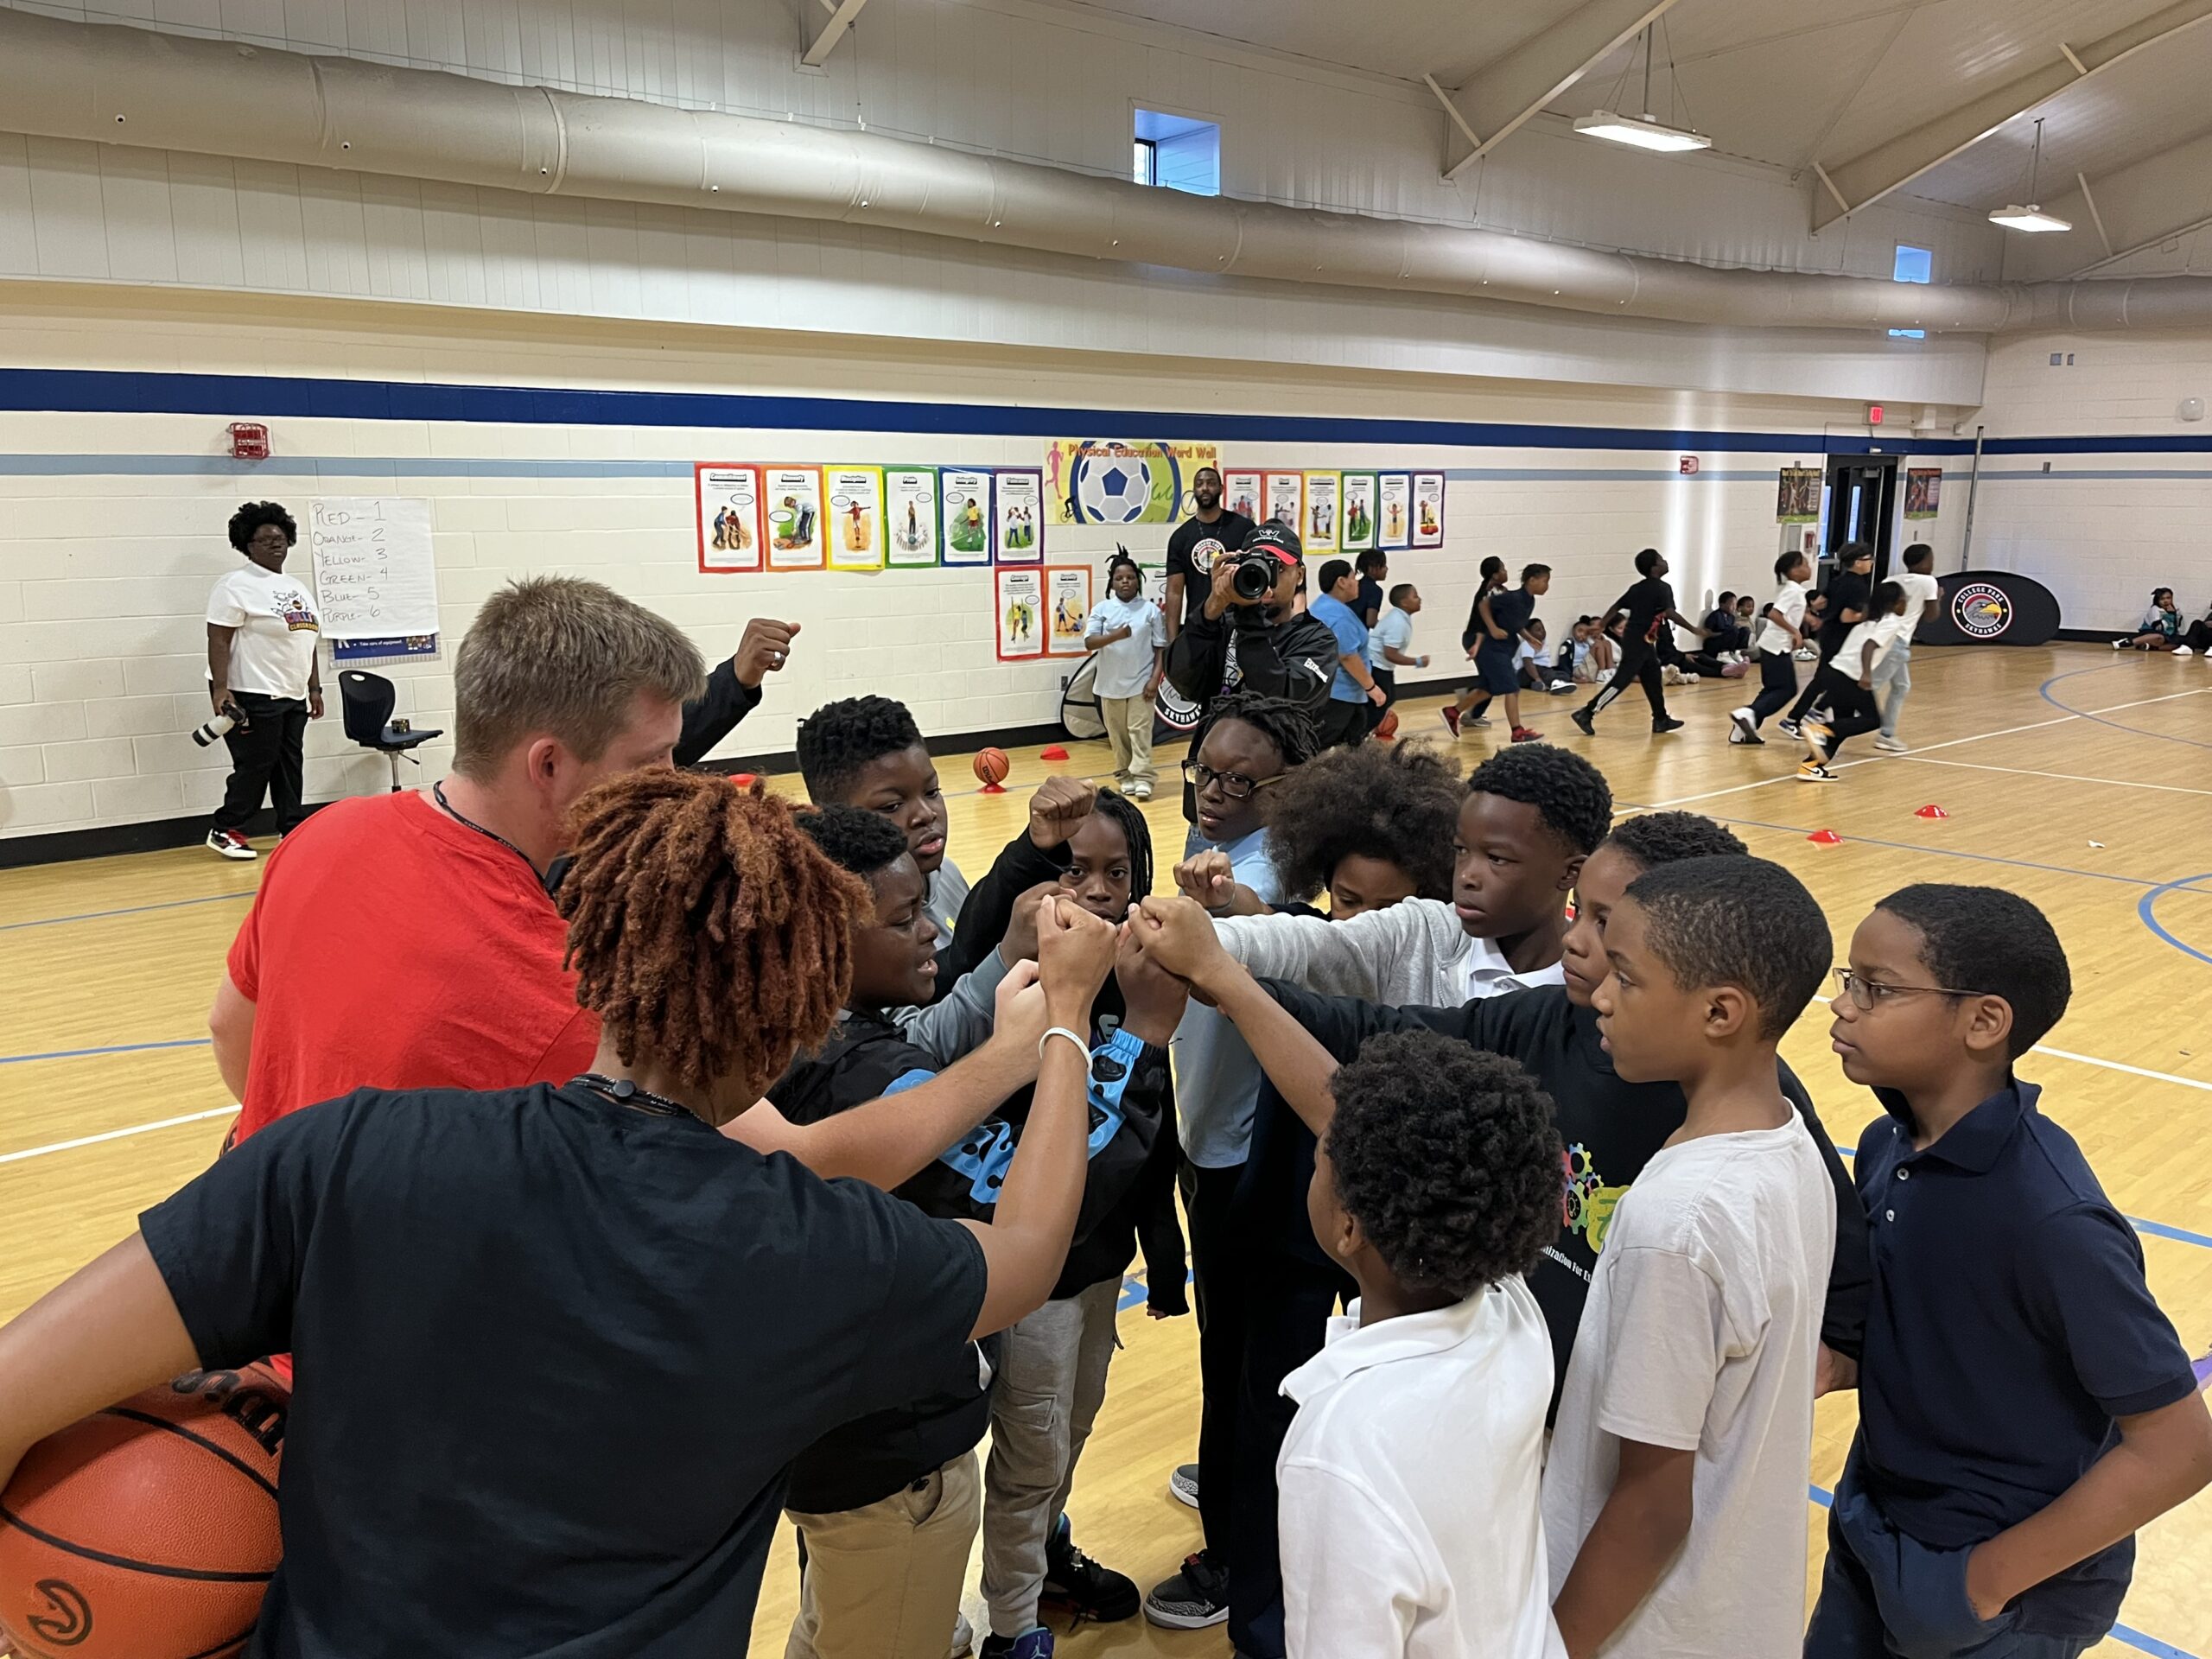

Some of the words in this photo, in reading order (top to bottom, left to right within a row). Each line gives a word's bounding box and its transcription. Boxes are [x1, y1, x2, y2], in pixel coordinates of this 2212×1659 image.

[1068, 442, 1110, 459] Physical
[1115, 444, 1163, 459] Education
[1166, 444, 1192, 459] Word
[1196, 447, 1217, 459] Wall
[313, 503, 351, 526] RED
[373, 500, 386, 521] 1
[371, 527, 386, 542] 2
[375, 548, 388, 560] 3
[379, 567, 388, 581] 4
[367, 587, 380, 601] 5
[1958, 587, 1986, 603] COLLEGE
[1987, 588, 2005, 602] PARK
[369, 605, 381, 618] 6
[1964, 623, 2002, 634] SKYHAWKS
